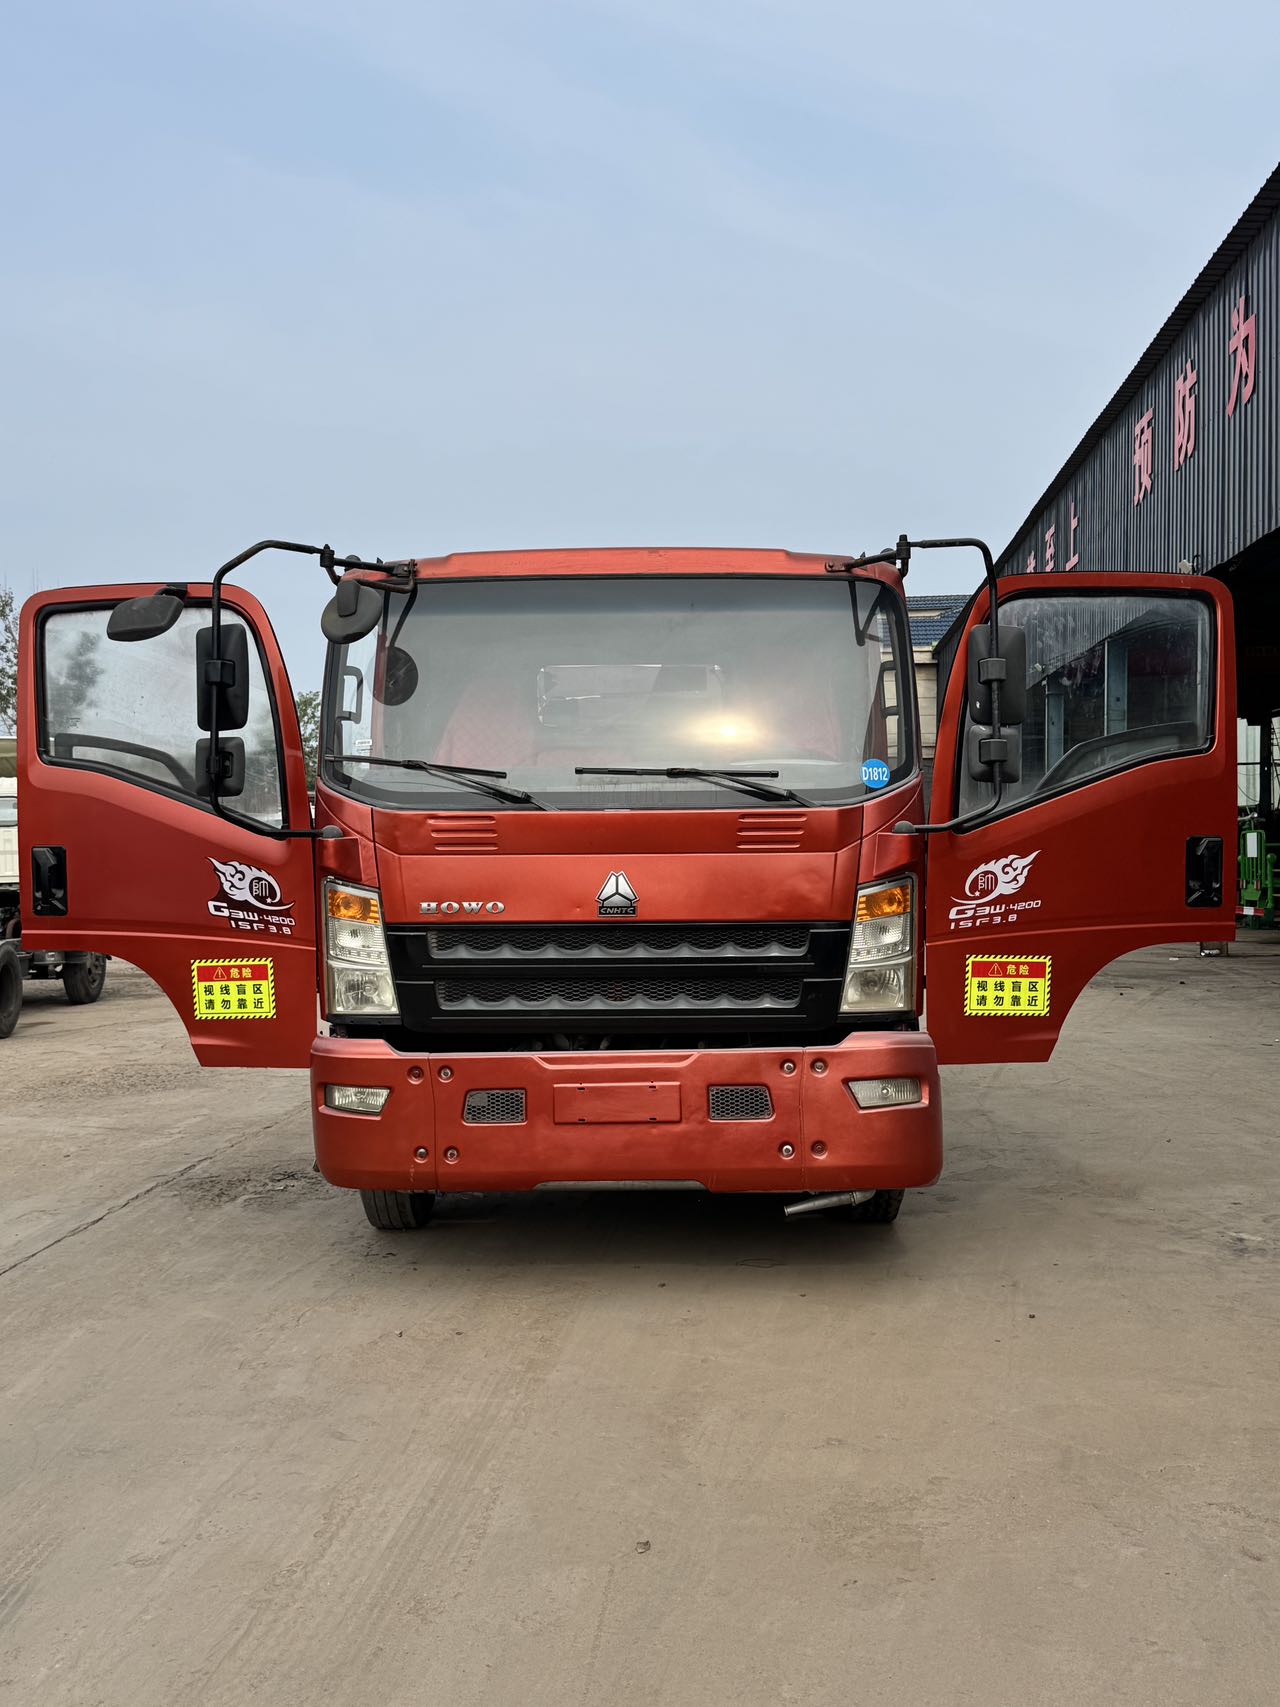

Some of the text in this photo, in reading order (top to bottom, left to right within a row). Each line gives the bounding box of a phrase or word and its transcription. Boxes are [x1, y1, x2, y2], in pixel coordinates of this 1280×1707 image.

[1133, 295, 1256, 508] 预防为
[862, 767, 888, 780] D1812
[419, 901, 506, 914] HOWO
[230, 967, 252, 979] 危险
[1006, 964, 1030, 975] 危险
[203, 984, 263, 996] 视线盲区
[976, 980, 1039, 992] 视线盲区
[204, 998, 264, 1010] 请勿靠近
[976, 995, 1039, 1007] 请勿靠近
